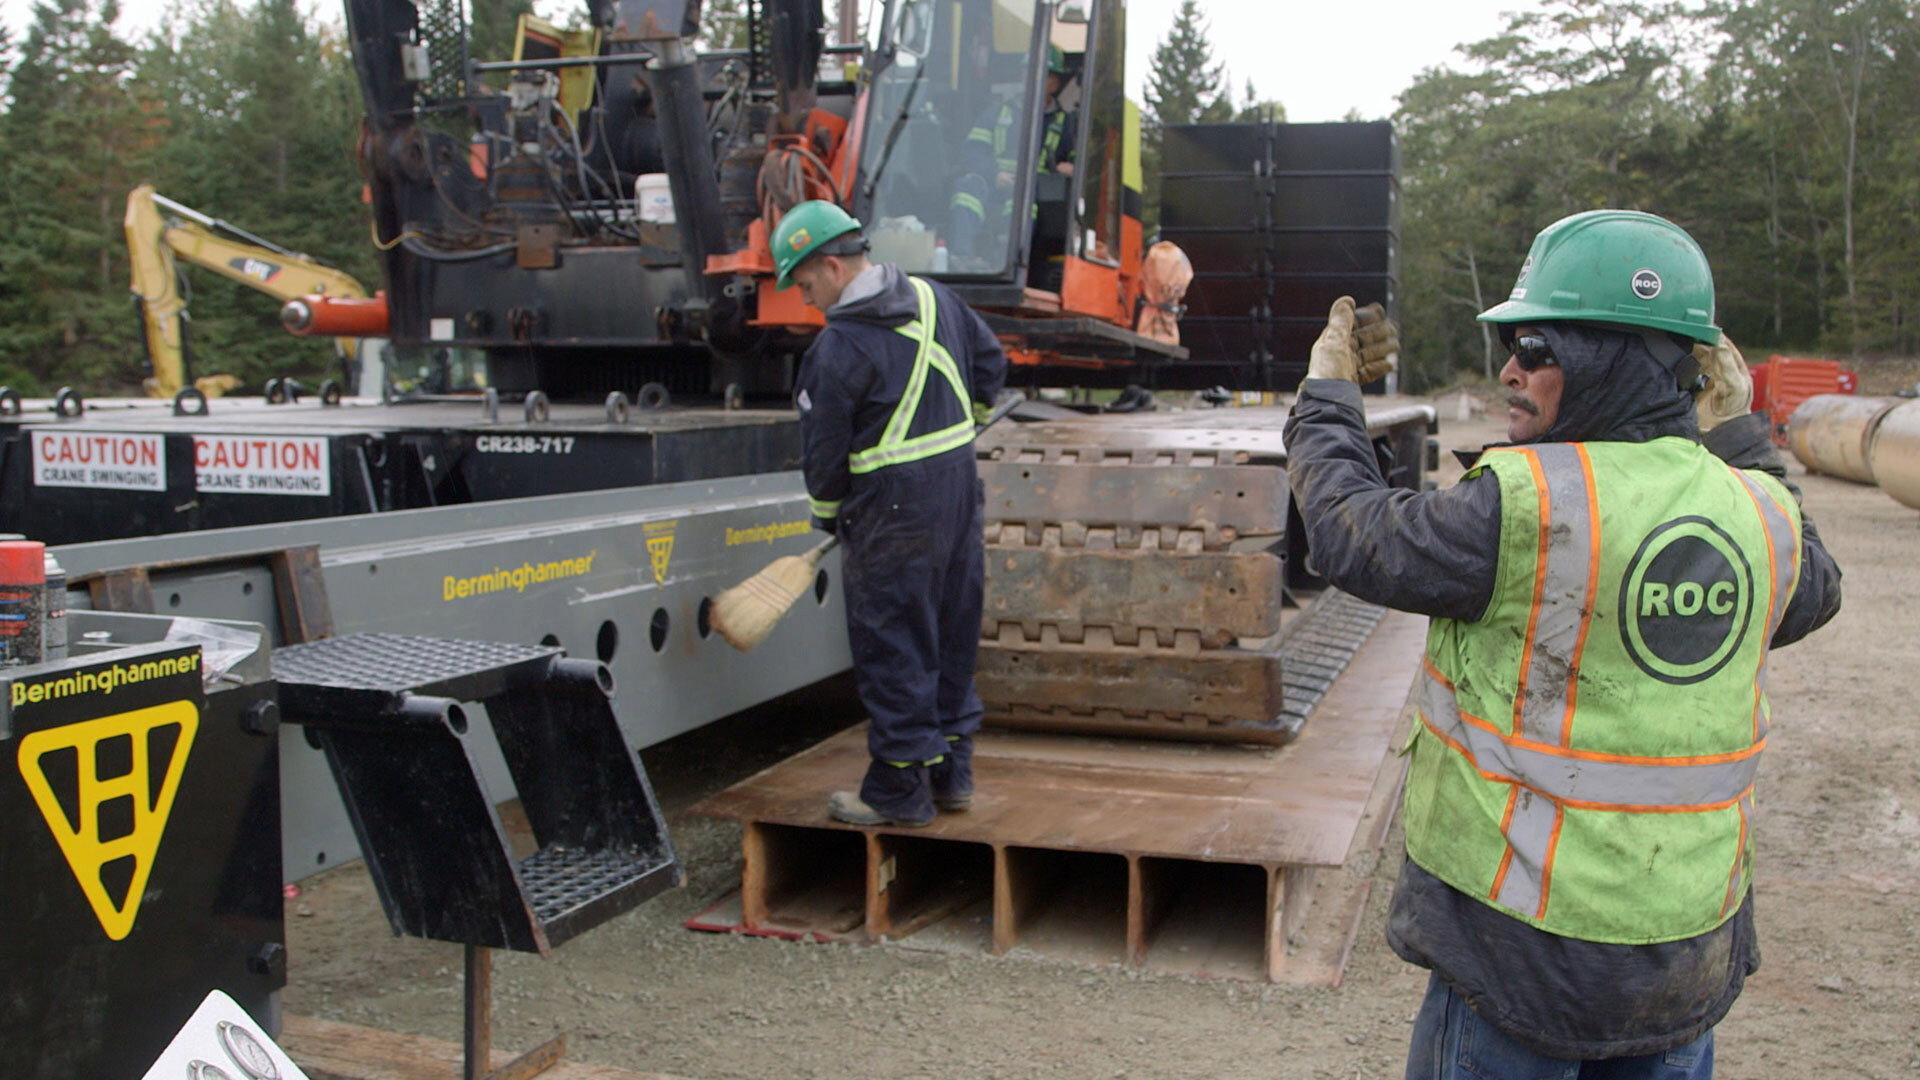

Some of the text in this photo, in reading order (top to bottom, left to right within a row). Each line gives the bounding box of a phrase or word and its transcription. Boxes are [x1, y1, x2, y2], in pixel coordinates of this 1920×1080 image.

[1635, 280, 1658, 289] ROC
[42, 436, 157, 466] CAUTION
[194, 440, 320, 469] CAUTION
[476, 436, 575, 453] CR238-717
[43, 469, 158, 486] CRANE SWINGING
[195, 474, 321, 490] CRANE SWINGING
[443, 556, 594, 601] Berminghammer
[1641, 581, 1735, 616] ROC
[11, 654, 200, 707] Berminghammer
